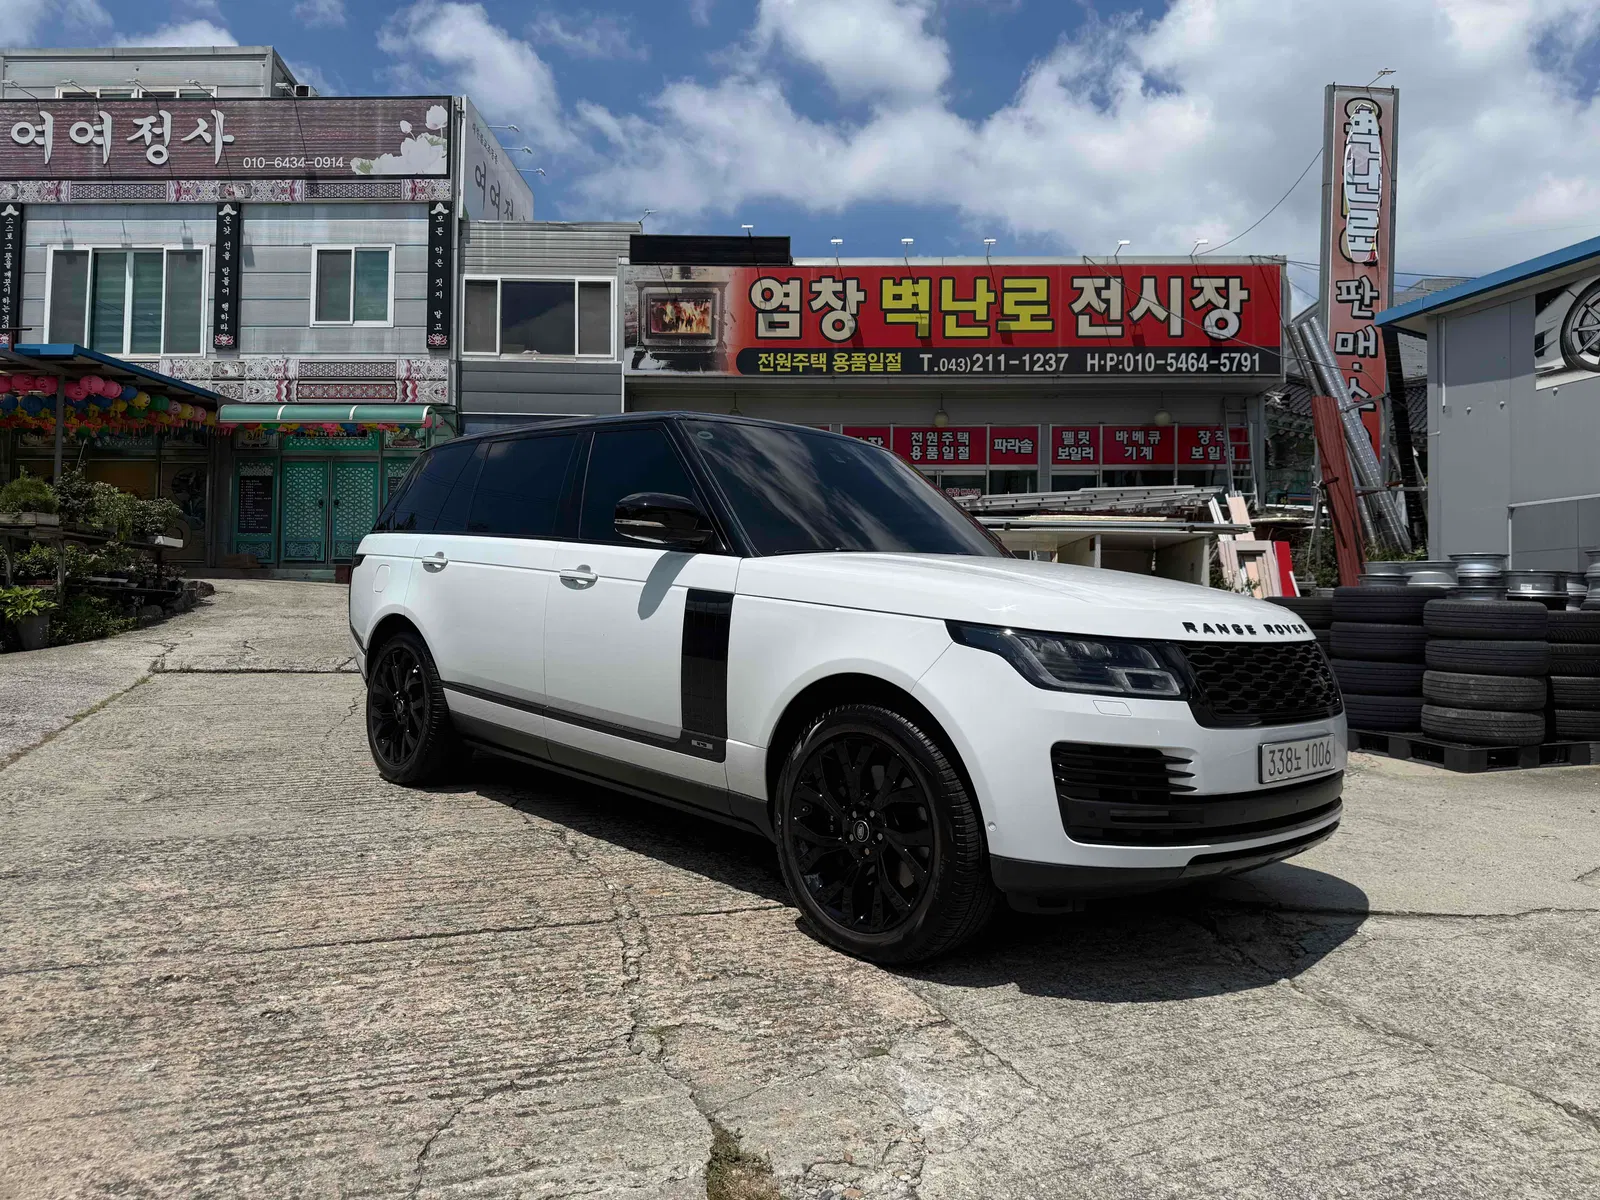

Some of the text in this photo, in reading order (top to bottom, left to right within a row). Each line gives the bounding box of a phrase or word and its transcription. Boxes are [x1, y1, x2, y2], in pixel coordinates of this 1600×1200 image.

[10, 109, 235, 165] 여여정사
[243, 156, 344, 169] 010-6434-0914
[435, 215, 444, 236] 모든
[749, 275, 1250, 343] 염창 벽난로 전시장
[757, 352, 828, 373] 전원주택
[832, 352, 902, 373] 용품일절
[910, 431, 970, 446] 전원주택
[1115, 430, 1161, 445] 바베큐
[993, 438, 1034, 453] 파라솔
[1124, 446, 1153, 460] 기계
[910, 446, 970, 461] 용품일절
[1057, 446, 1094, 461] 보일러
[1181, 621, 1307, 635] RANGE ROVER
[1304, 740, 1332, 770] 1006
